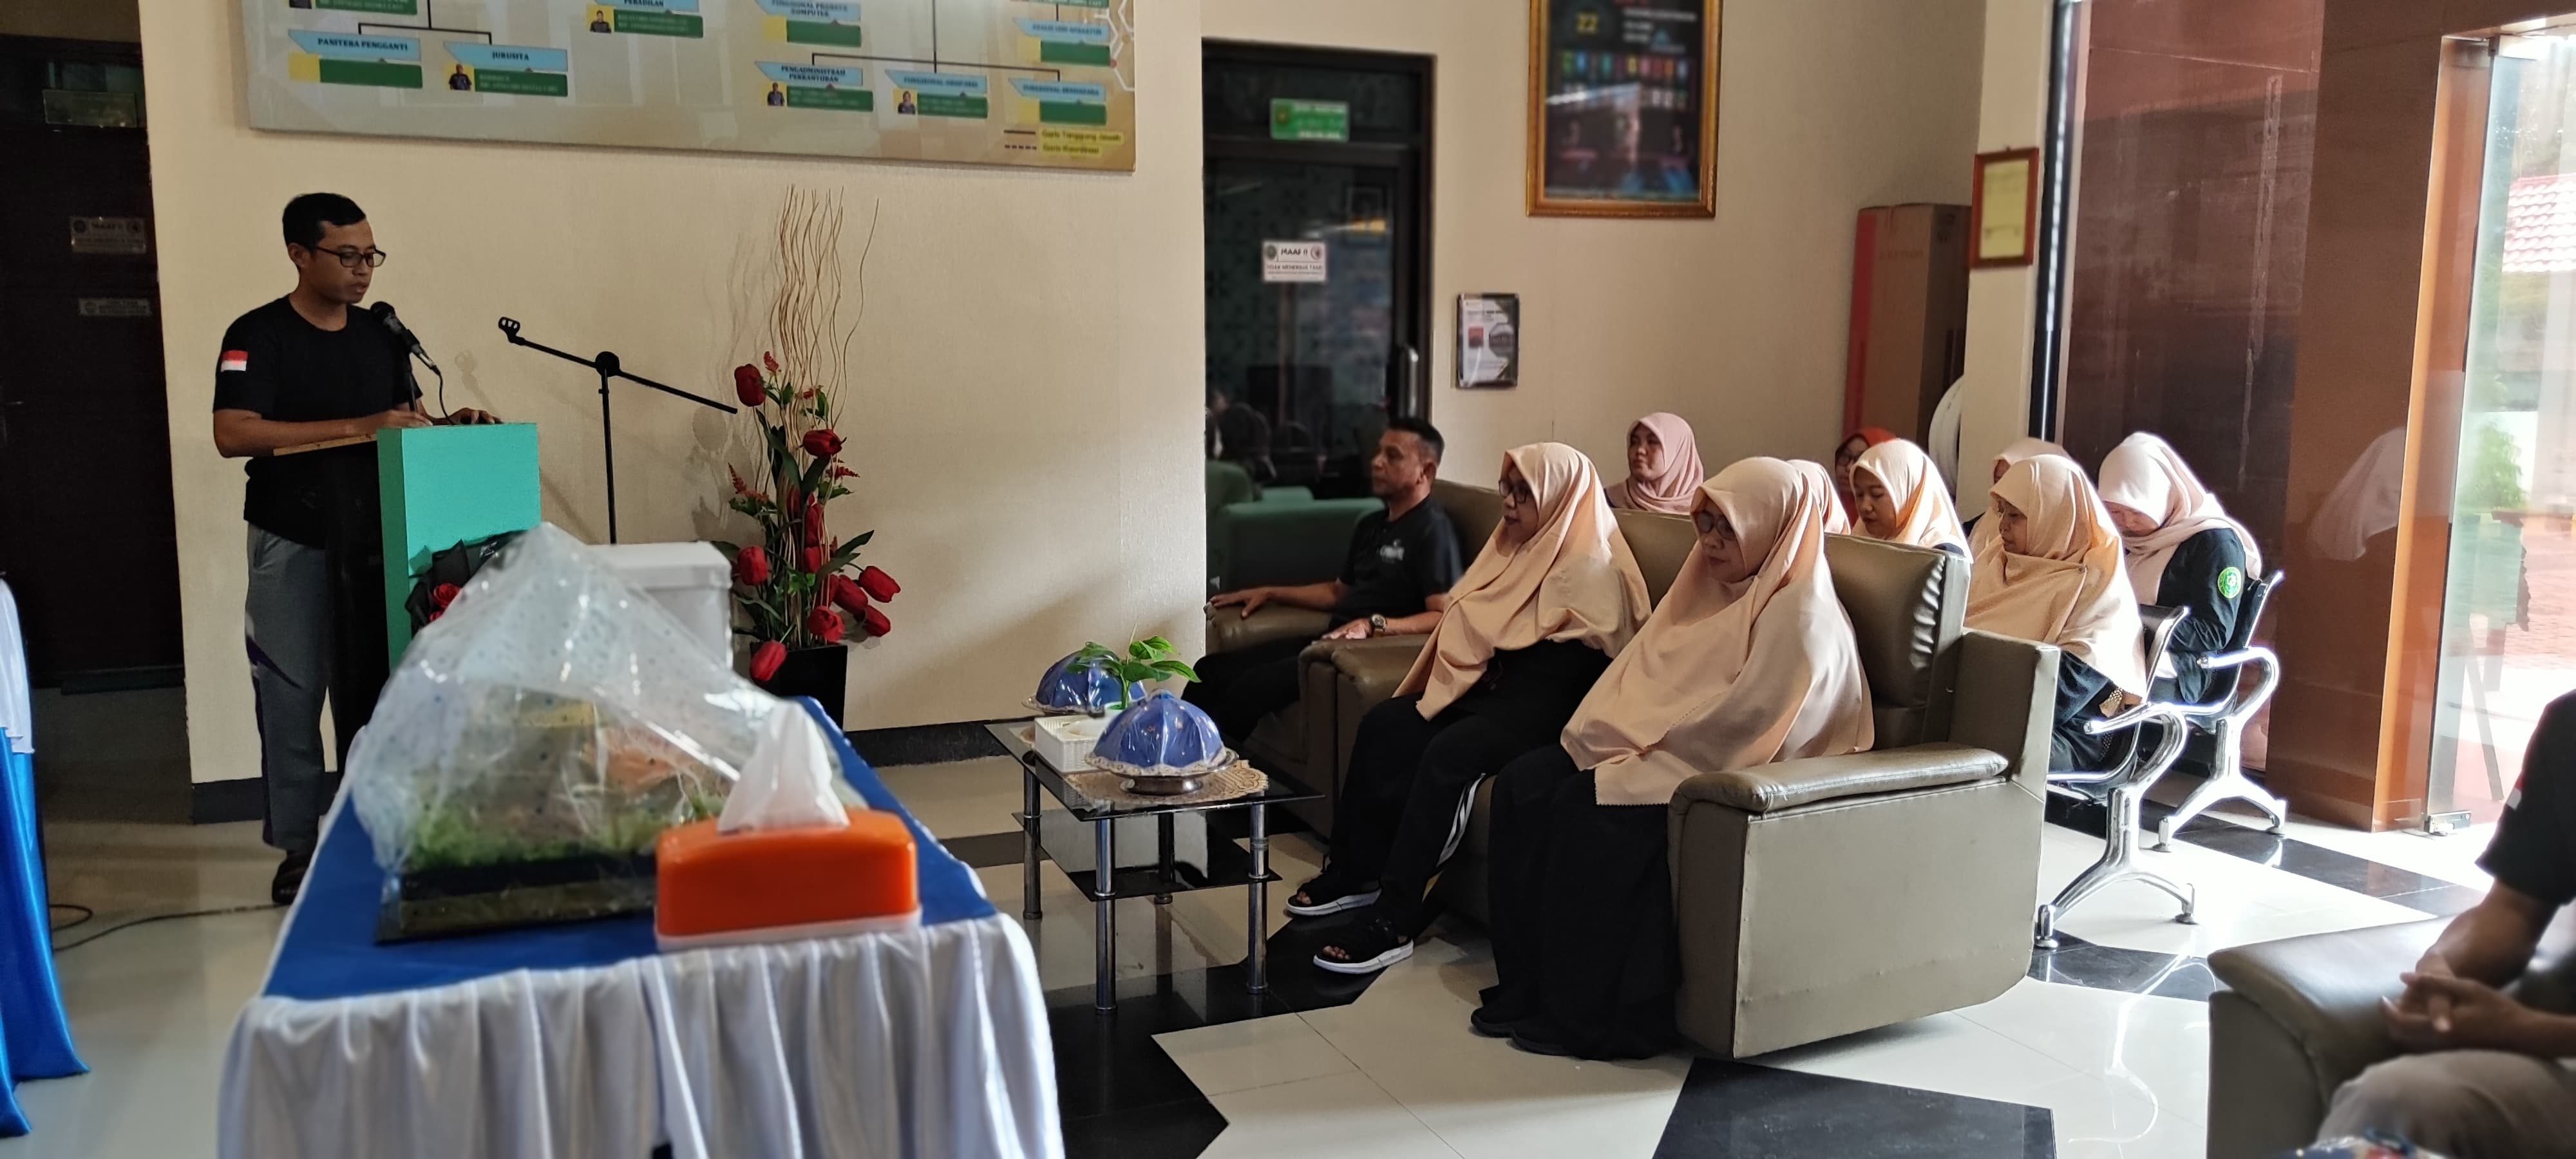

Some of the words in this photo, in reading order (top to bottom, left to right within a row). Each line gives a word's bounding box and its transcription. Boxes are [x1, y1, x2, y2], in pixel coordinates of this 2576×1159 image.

[317, 37, 359, 48] PANITERA
[361, 41, 408, 51] PENGGANTI
[492, 51, 529, 61] JURUSITA
[781, 65, 846, 75] PENGADMINISTRASI
[789, 73, 838, 82] PERKANTORAN
